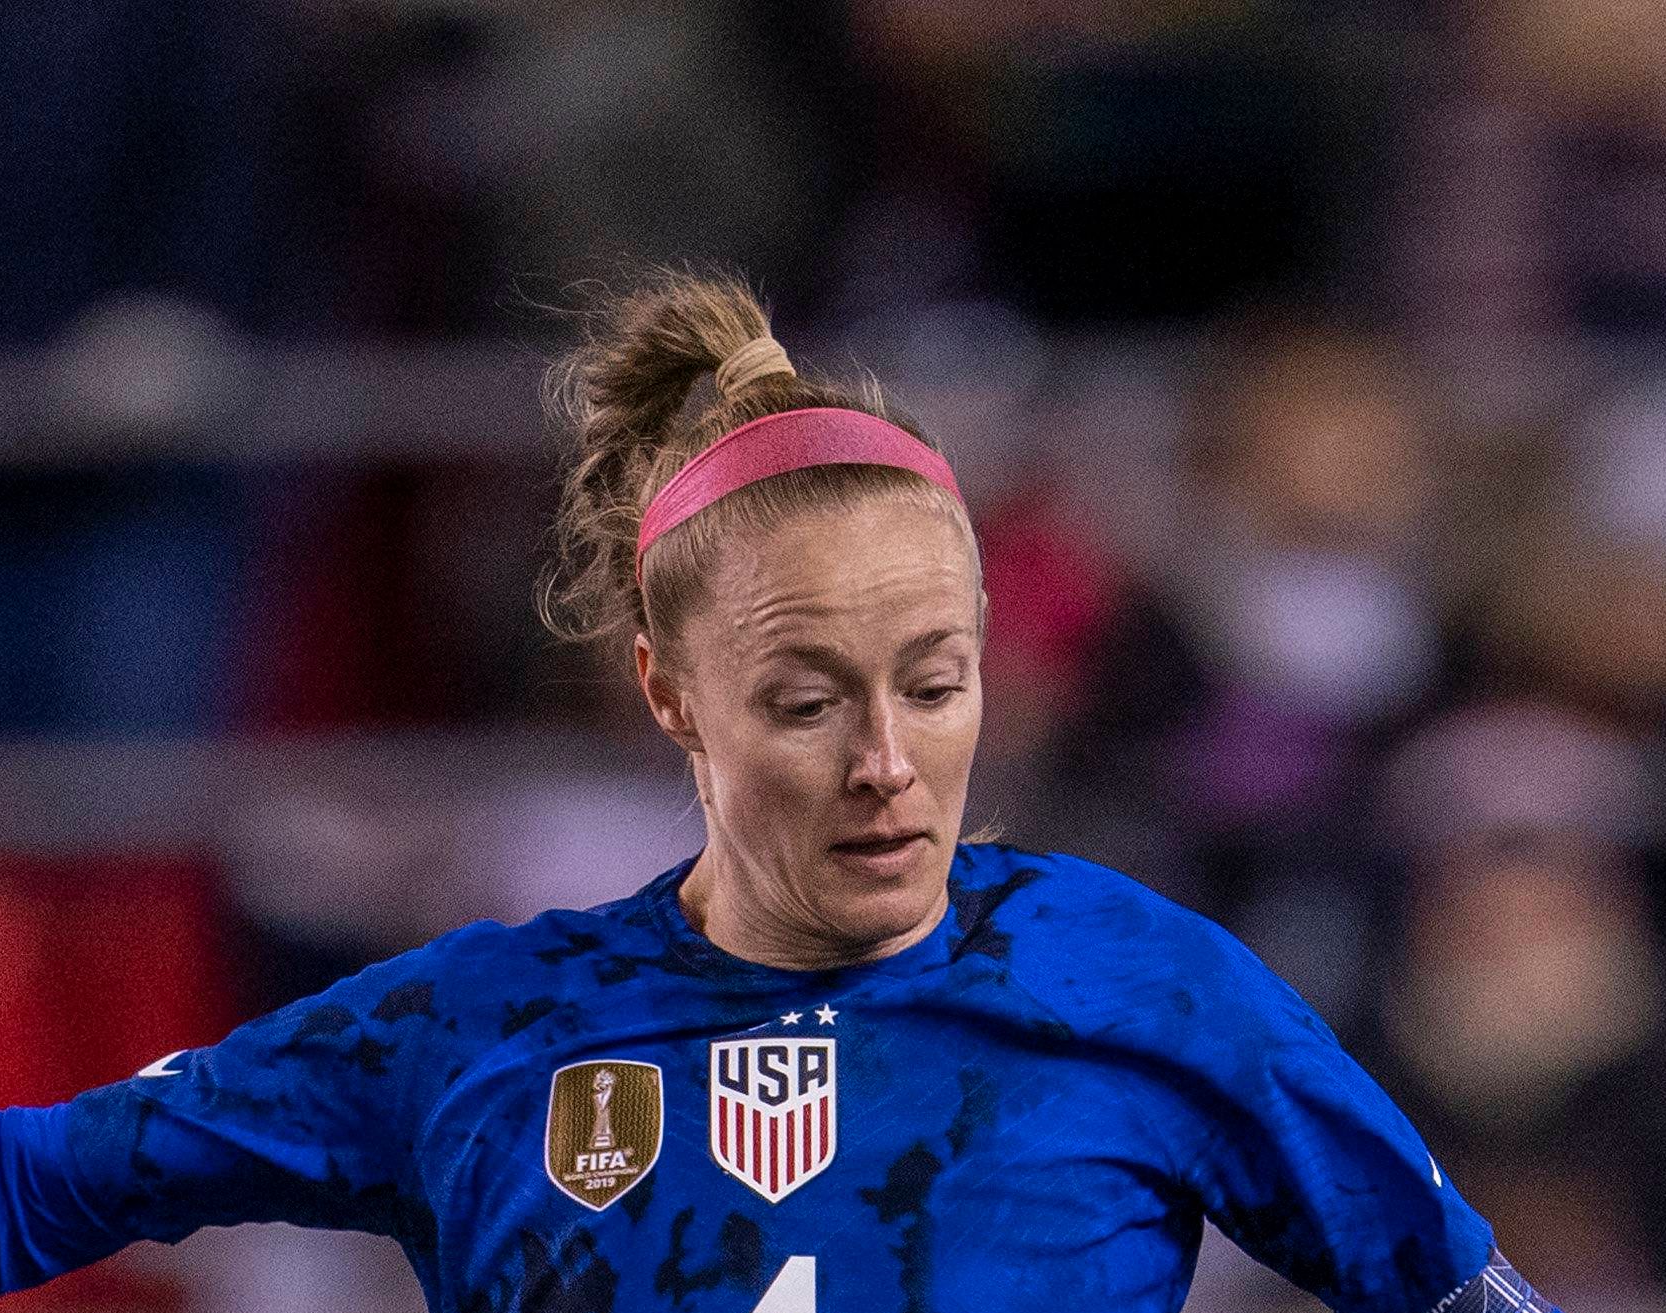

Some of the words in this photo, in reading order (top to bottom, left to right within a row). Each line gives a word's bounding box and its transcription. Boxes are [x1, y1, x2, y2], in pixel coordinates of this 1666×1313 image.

[717, 1045, 829, 1107] USA
[576, 1150, 627, 1172] FIFA
[585, 1177, 616, 1190] 2019
